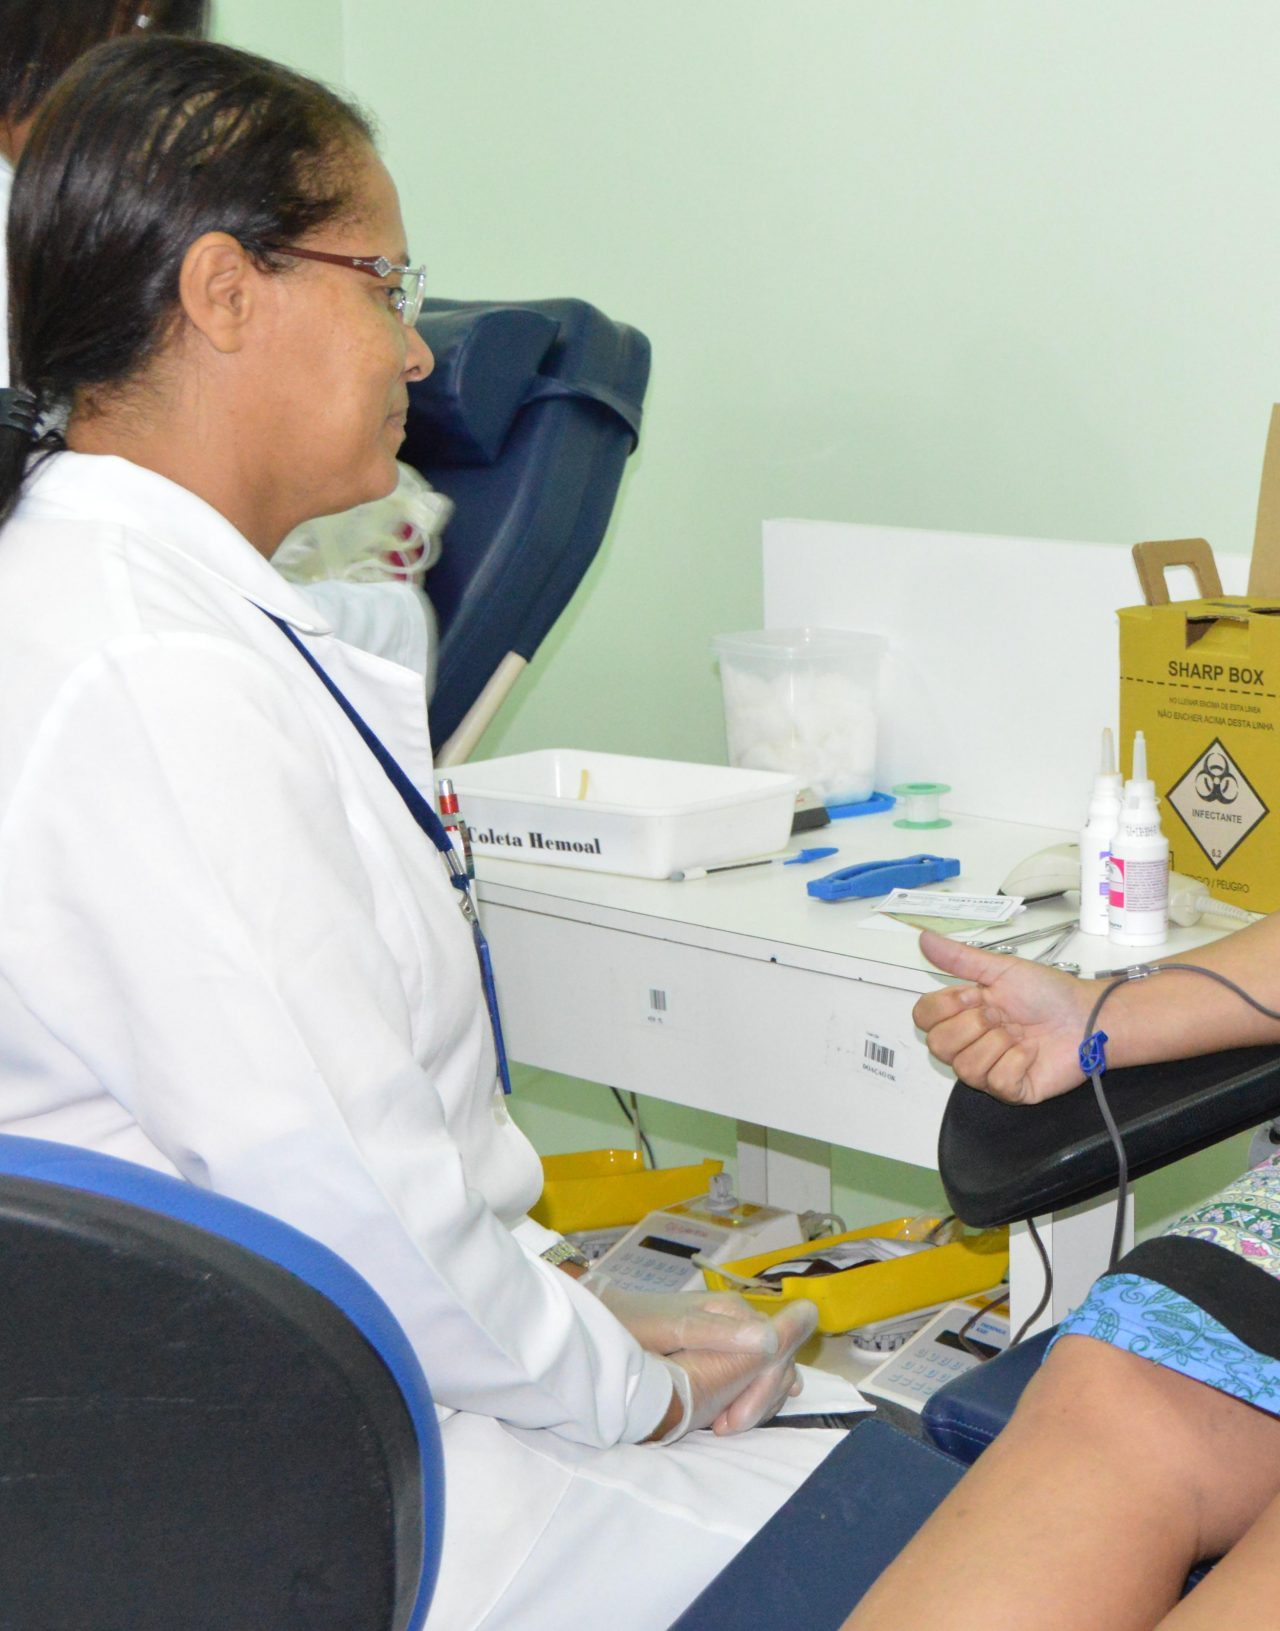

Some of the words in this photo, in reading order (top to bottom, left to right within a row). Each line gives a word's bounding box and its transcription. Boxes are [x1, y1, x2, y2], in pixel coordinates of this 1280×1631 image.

[1168, 660, 1224, 681] SHARP
[1229, 667, 1265, 686] BOX
[1157, 708, 1172, 719] NÃO
[1173, 711, 1203, 723] ENCHER
[1204, 714, 1226, 726] ACIMA
[1228, 718, 1251, 729] DESTA
[1251, 721, 1274, 731] LINHA
[1192, 808, 1243, 824] INFECTANTE
[466, 826, 523, 847] Coleta
[528, 832, 602, 854] Hemoal
[1211, 848, 1222, 858] 6.2
[1216, 879, 1250, 893] PELIGRO
